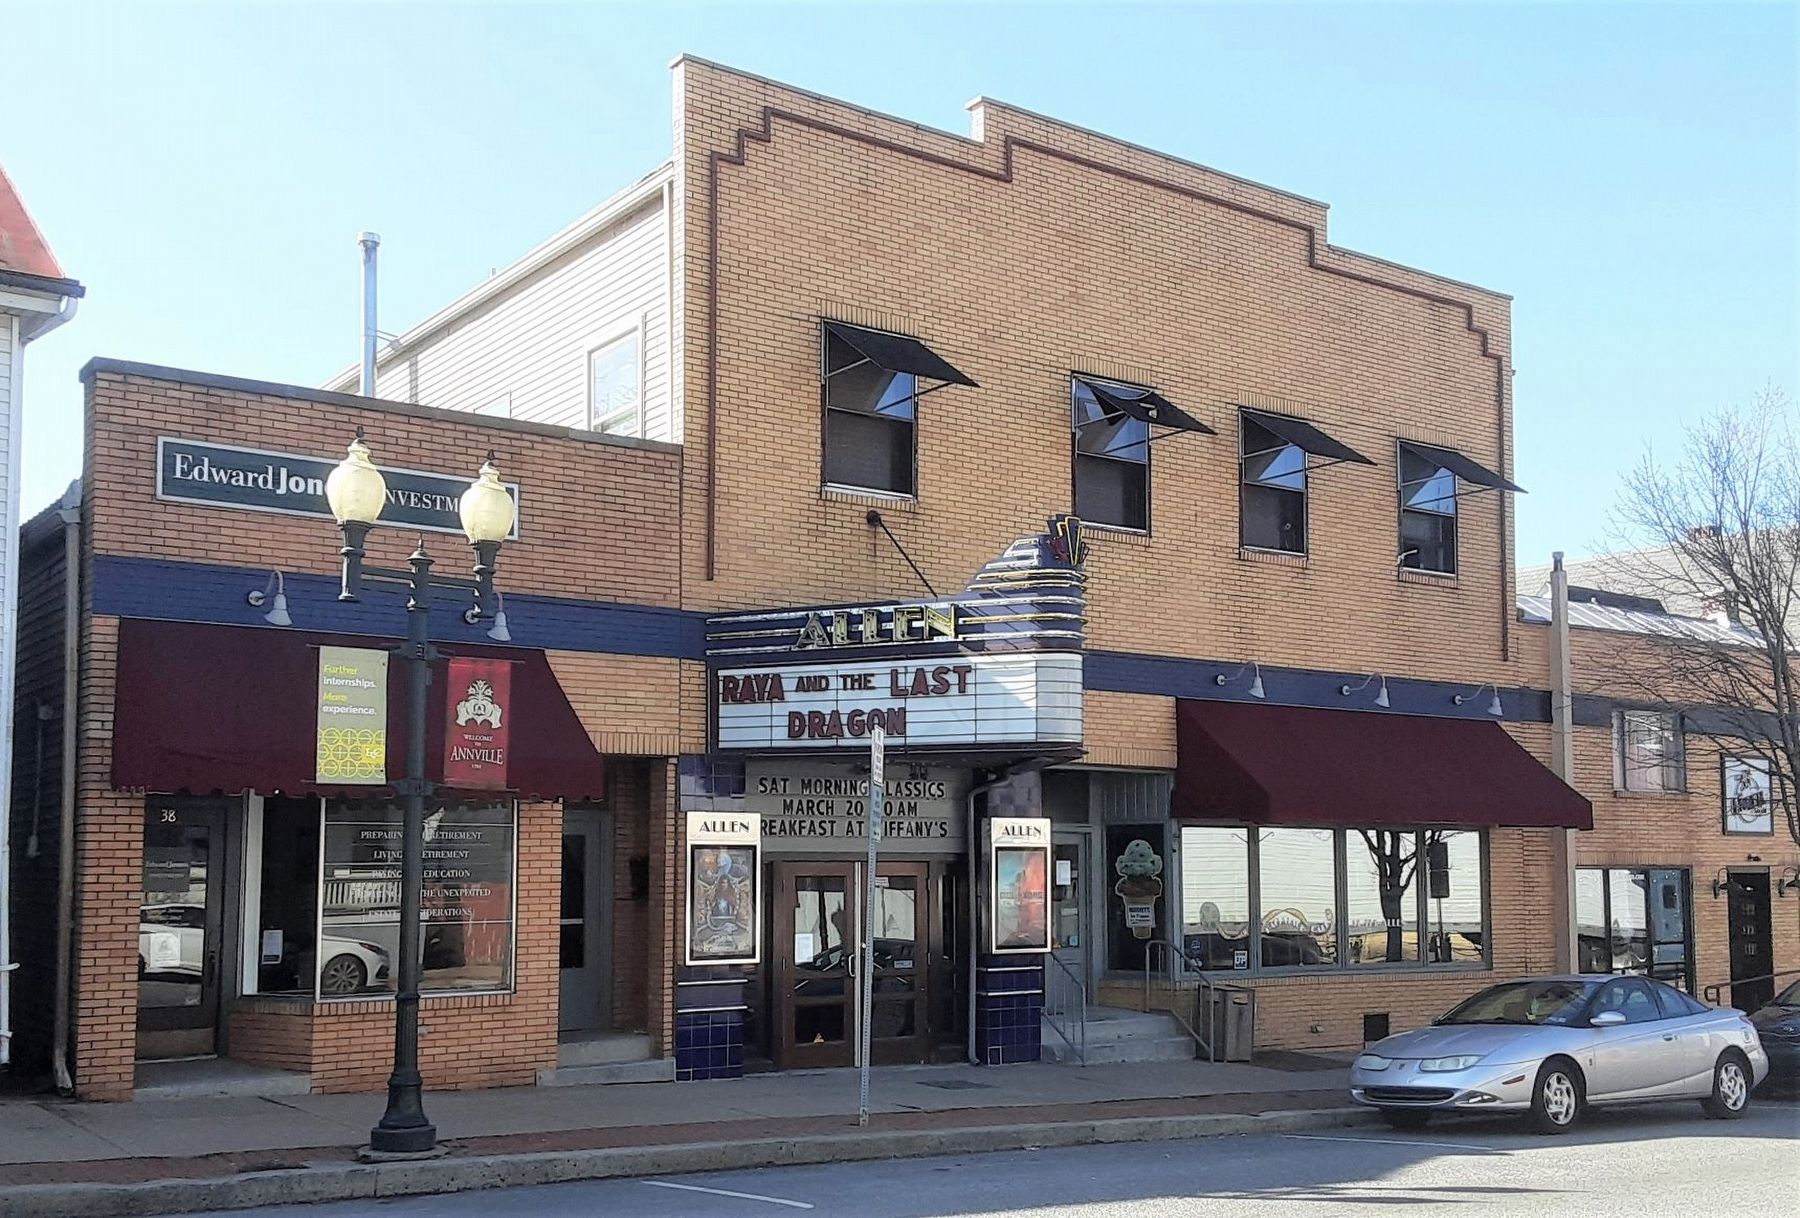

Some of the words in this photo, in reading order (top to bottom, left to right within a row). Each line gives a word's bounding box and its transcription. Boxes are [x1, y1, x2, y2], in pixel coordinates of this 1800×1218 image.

[385, 488, 460, 513] NVESTM
[796, 604, 959, 649] ALLEN
[721, 673, 785, 703] RAYA
[795, 675, 830, 692] AND
[839, 673, 876, 691] THE
[890, 665, 973, 697] LAST
[787, 706, 906, 738] DRAGON
[450, 745, 504, 765] ANNVILLE
[759, 777, 790, 794] SAT
[800, 778, 868, 796] MORNING
[885, 780, 945, 798] LASSICS
[161, 809, 177, 823] 38
[782, 799, 835, 816] MARCH
[846, 800, 864, 817] 20
[360, 831, 403, 840] PREPARIN
[700, 820, 750, 833] ALLEN
[760, 819, 837, 837] REAKFAST
[846, 820, 865, 837] AT
[884, 821, 948, 838] IFFANY'S
[1002, 825, 1042, 837] ALLEN
[421, 850, 470, 859] ETIREMENT
[423, 869, 471, 878] EDUCATION
[437, 888, 491, 897] UNEXPECTED
